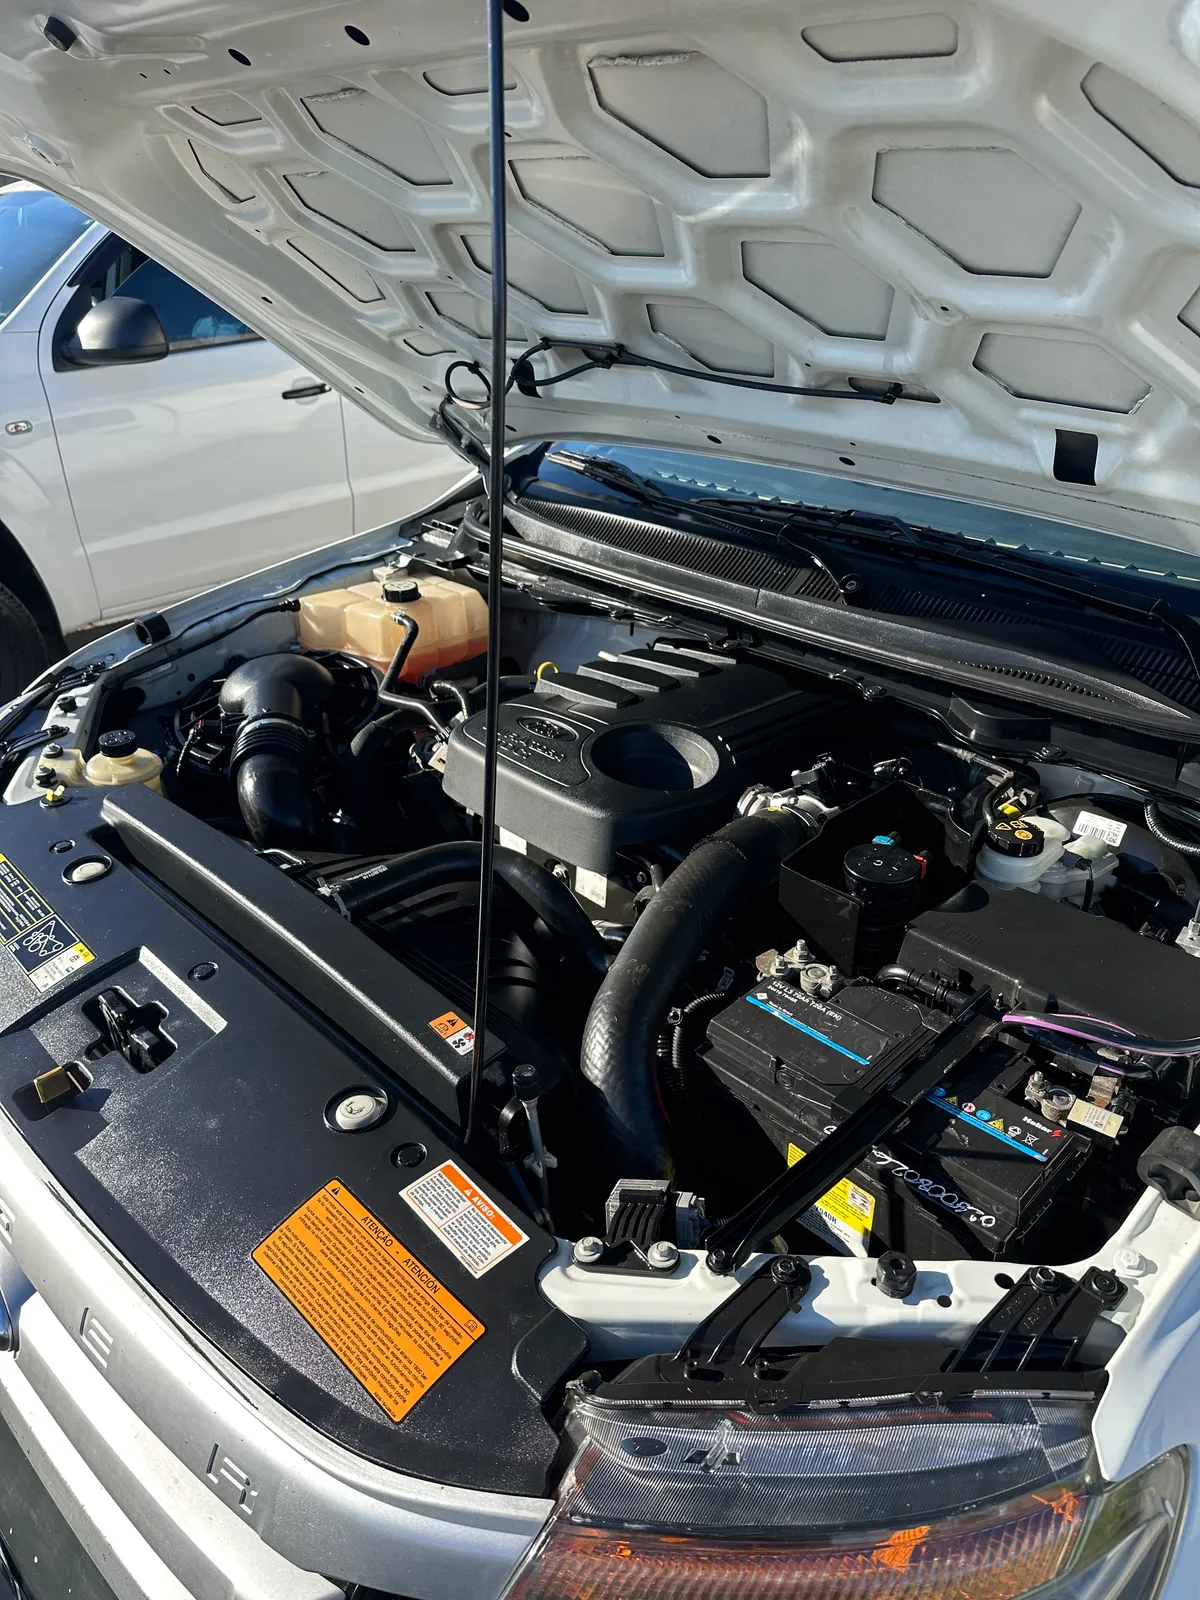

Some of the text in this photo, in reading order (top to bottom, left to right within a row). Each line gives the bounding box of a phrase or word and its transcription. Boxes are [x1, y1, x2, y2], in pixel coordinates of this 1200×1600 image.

[471, 1194, 495, 1219] AVISO:
[360, 1215, 394, 1248] ATENÇÃO
[402, 1257, 440, 1294] ATENCIÓN
